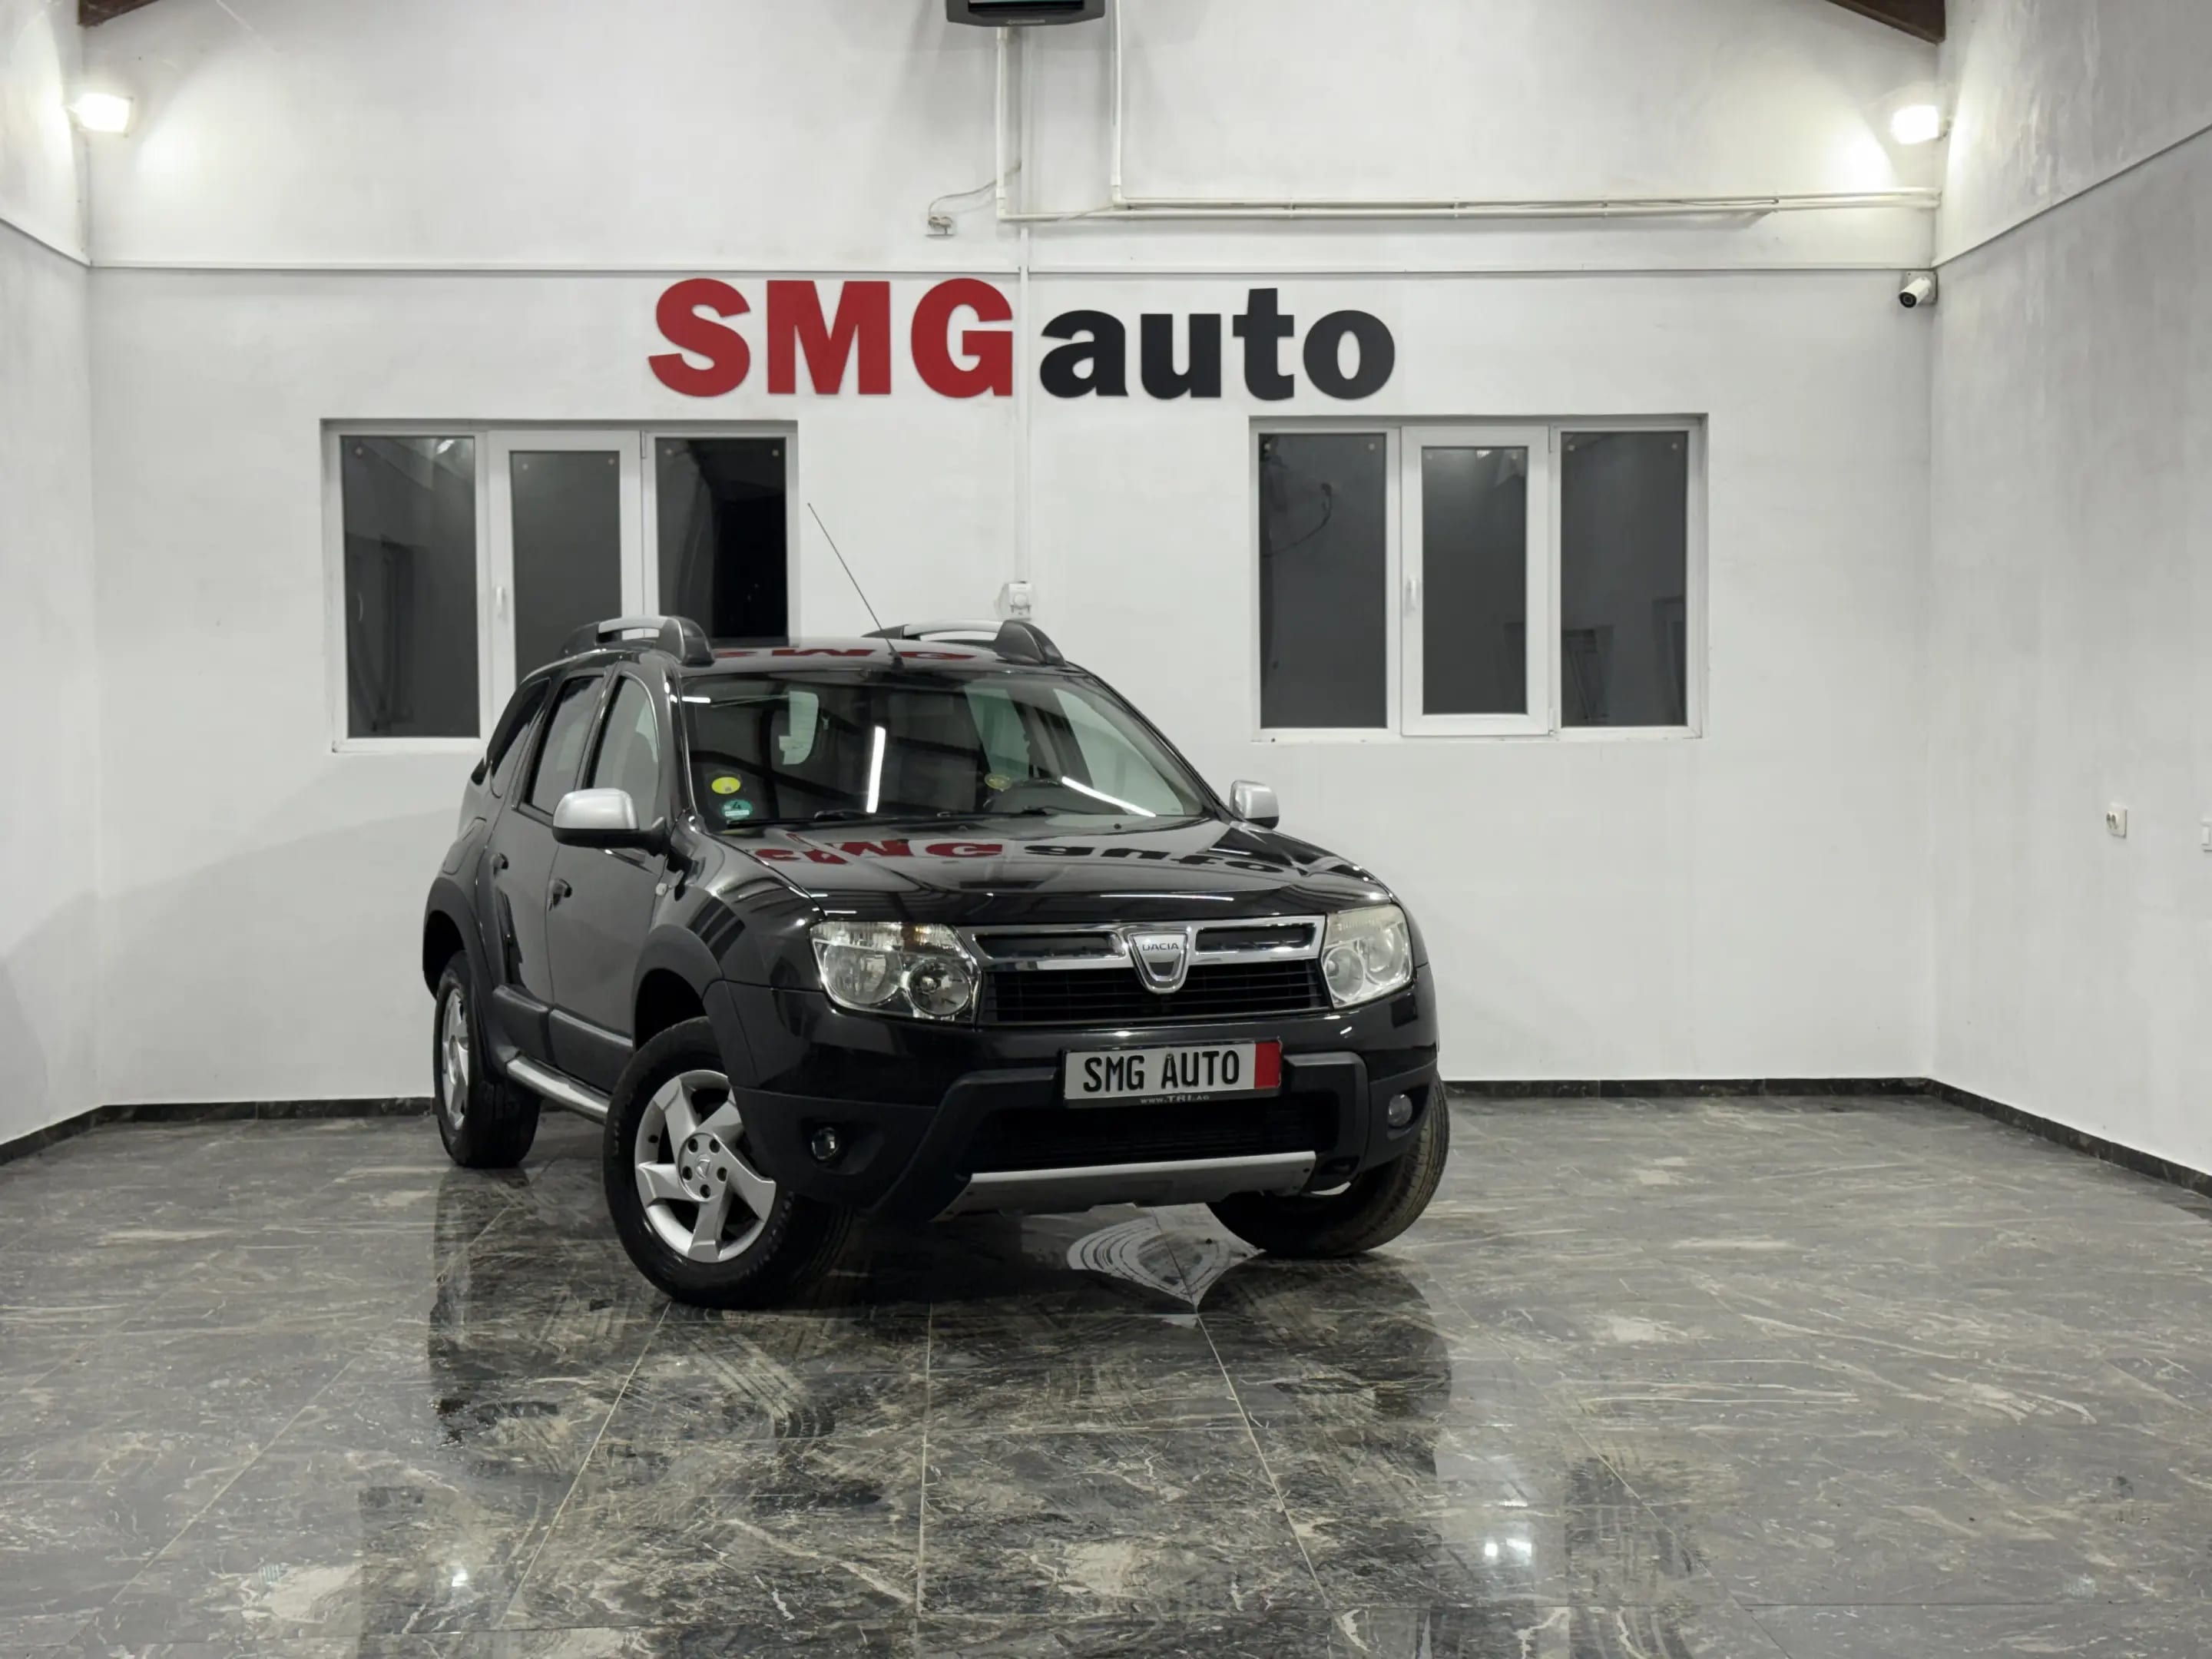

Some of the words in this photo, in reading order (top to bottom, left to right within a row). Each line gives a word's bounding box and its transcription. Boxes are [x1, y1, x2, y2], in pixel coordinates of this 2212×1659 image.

[1142, 942, 1179, 951] DACIA
[1083, 1055, 1144, 1092] SMG
[1161, 1050, 1240, 1089] AUTO
